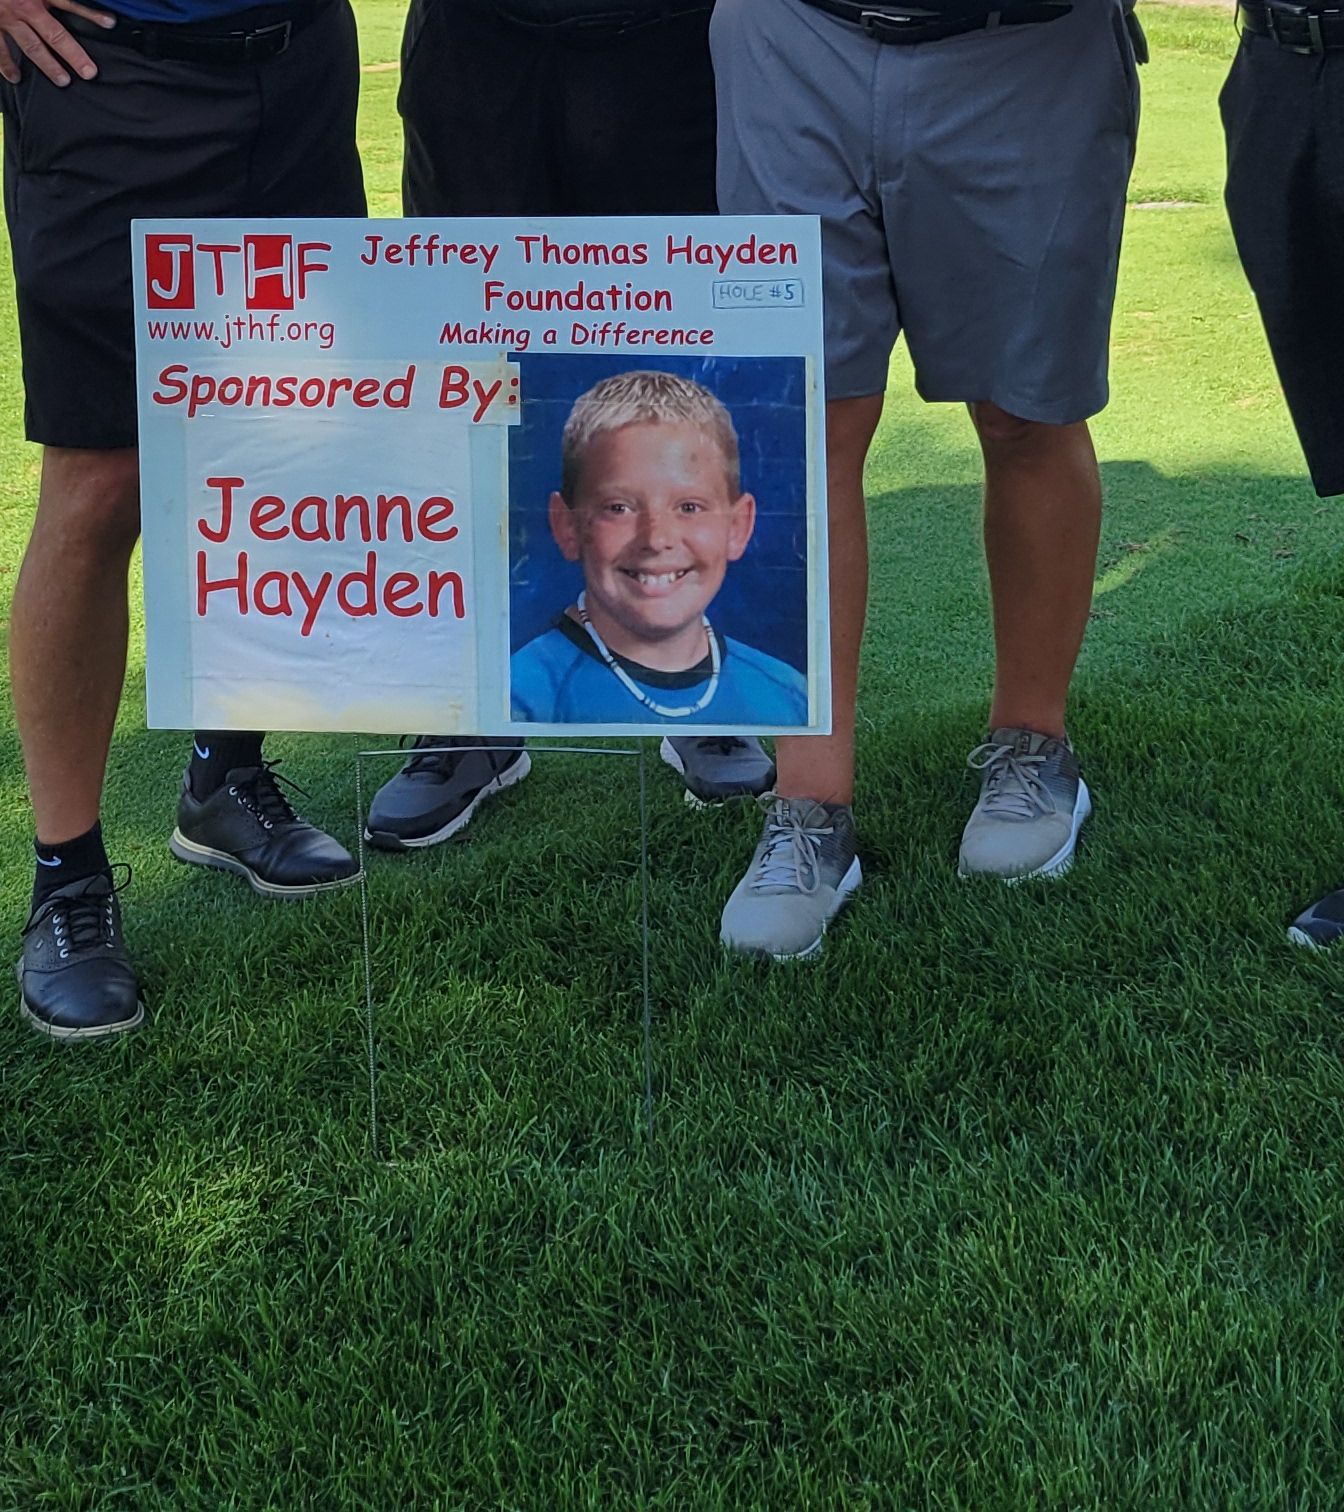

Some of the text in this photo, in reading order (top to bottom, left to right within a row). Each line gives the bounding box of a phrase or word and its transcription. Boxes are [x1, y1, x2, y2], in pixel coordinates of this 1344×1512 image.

[145, 234, 333, 310] JTHF
[360, 233, 798, 274] Jeffrey Thomas Hayden
[483, 280, 673, 312] Foundation
[719, 283, 795, 302] HOLE #5
[147, 313, 336, 349] www.jthf.org
[438, 321, 715, 351] Making a Difference
[152, 363, 520, 423] Sponsored By:
[197, 476, 459, 545] Jeanne
[196, 550, 466, 637] Hayden
